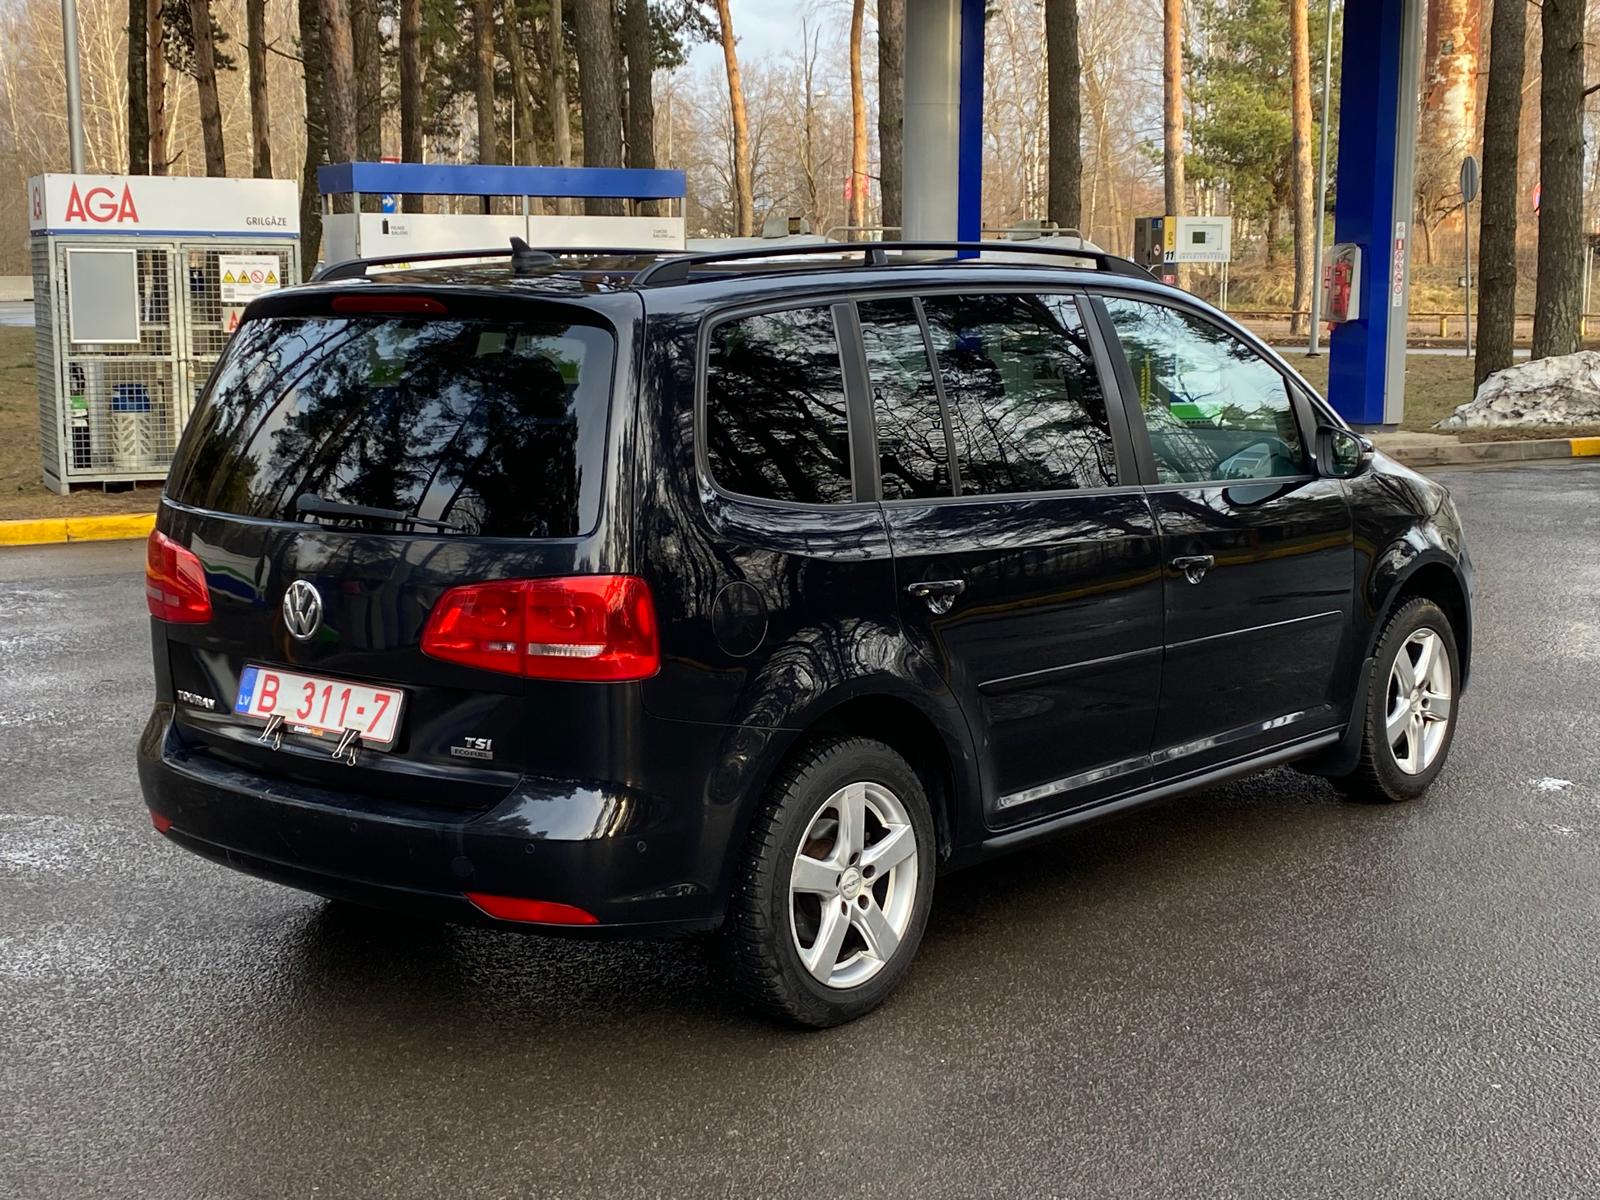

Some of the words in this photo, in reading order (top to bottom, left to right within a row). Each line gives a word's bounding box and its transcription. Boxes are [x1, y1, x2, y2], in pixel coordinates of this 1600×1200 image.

[65, 181, 140, 223] AGA
[1165, 250, 1175, 261] 11
[238, 694, 250, 706] LV
[257, 673, 280, 713] B
[296, 681, 391, 733] 311-7
[464, 736, 492, 750] TSI
